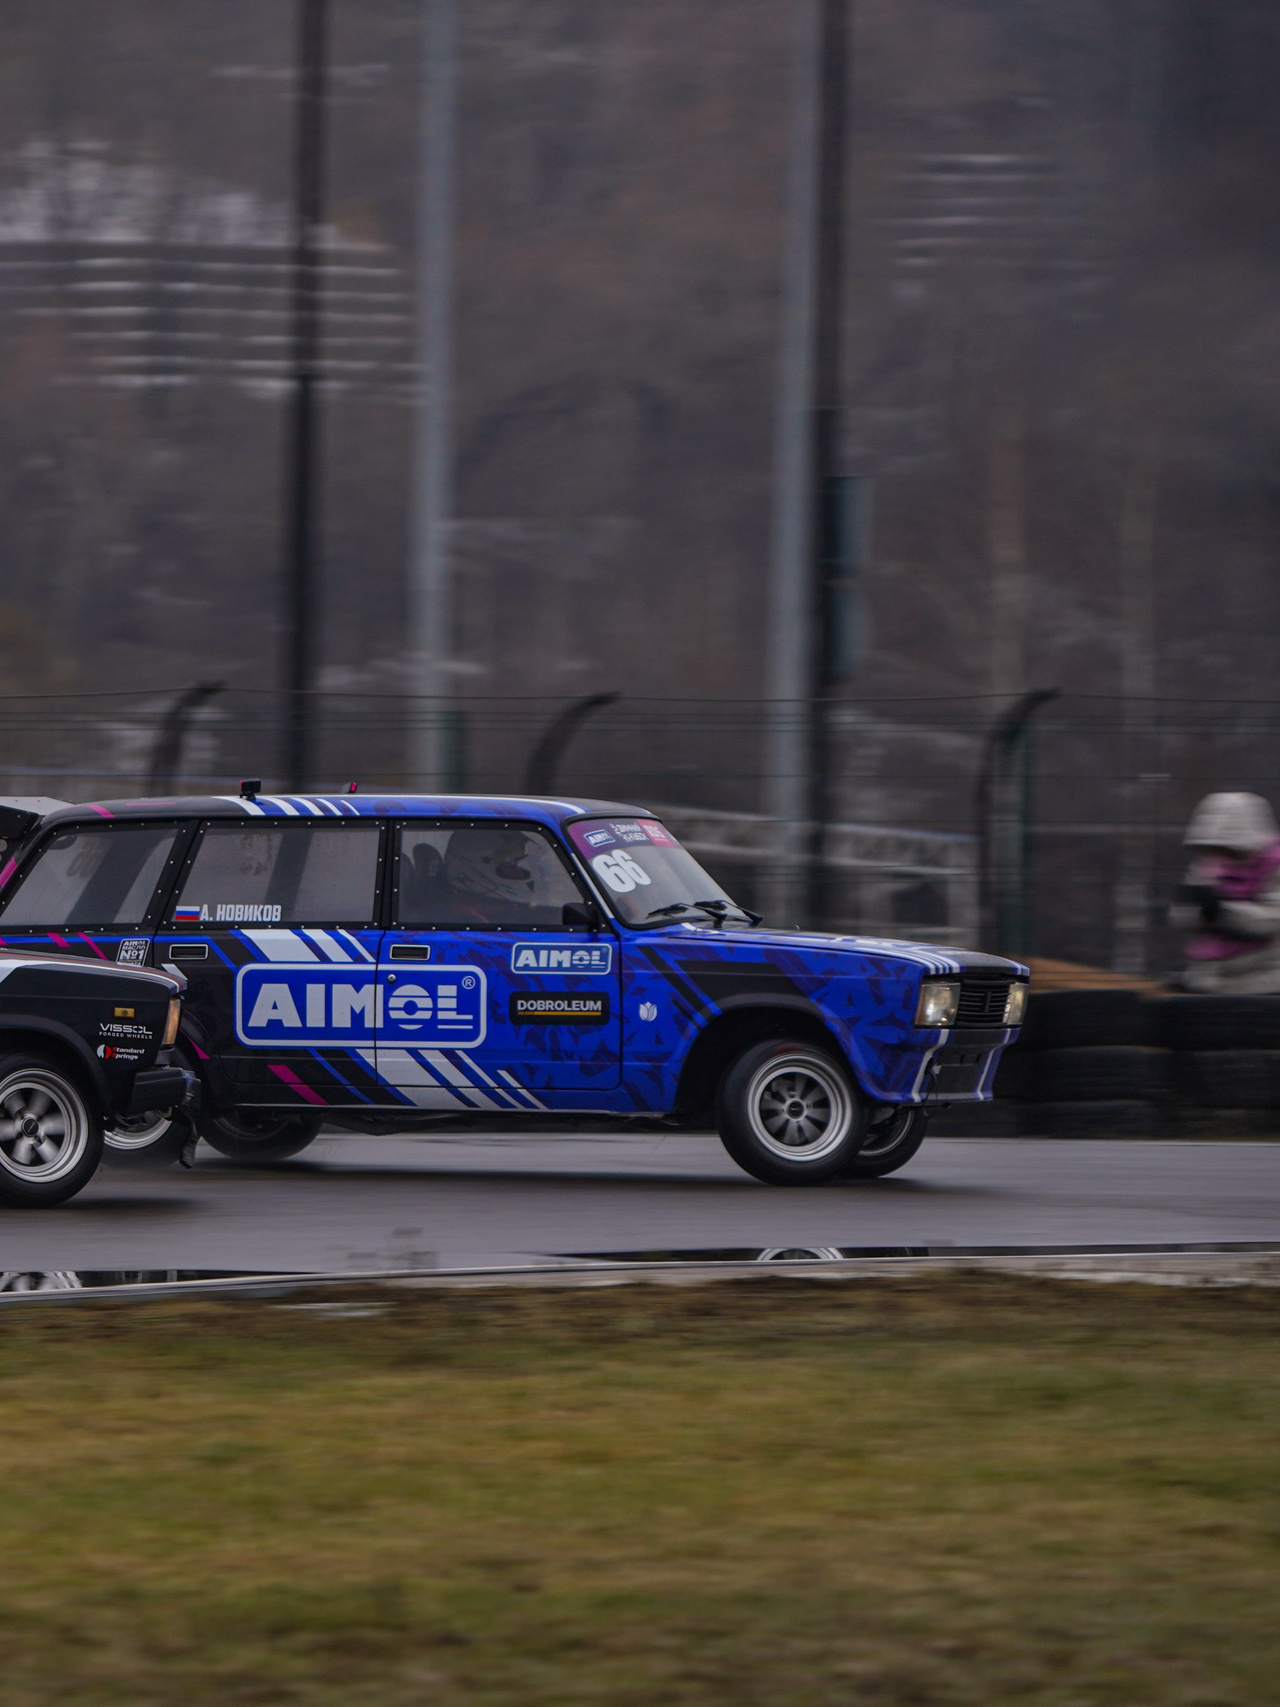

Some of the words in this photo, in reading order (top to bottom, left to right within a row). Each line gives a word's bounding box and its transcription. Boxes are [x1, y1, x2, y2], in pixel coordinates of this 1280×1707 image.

[592, 849, 651, 893] 66
[200, 904, 214, 921] А.
[217, 904, 281, 921] НОВИКОВ
[515, 950, 606, 968] AIMOL
[247, 983, 474, 1030] AIMOL
[517, 1000, 602, 1011] DOBROLEUM
